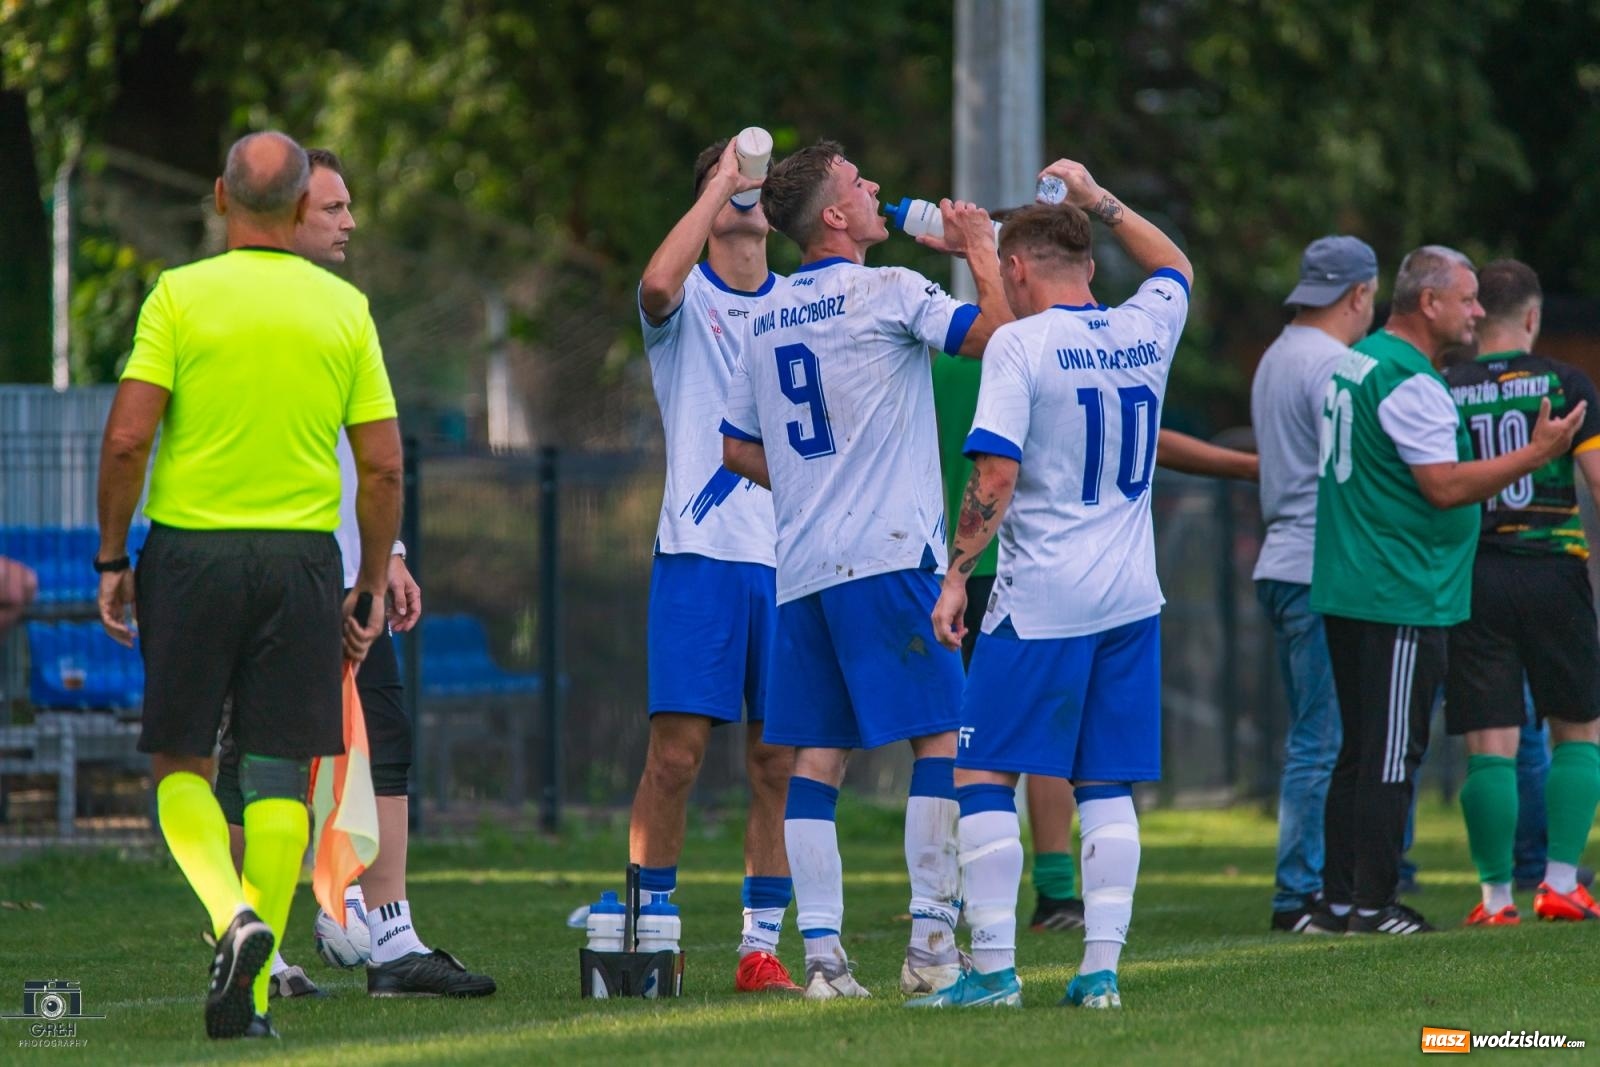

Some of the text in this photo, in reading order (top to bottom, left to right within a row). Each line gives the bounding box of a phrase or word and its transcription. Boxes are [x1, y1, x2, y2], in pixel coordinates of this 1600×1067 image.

[792, 277, 815, 287] 1946
[753, 294, 846, 337] UNIA RACIBÓRZ
[1056, 348, 1096, 370] UNIA
[774, 342, 836, 460] 9
[1076, 384, 1160, 506] 10
[1470, 409, 1535, 512] 10
[377, 924, 411, 946] adidas
